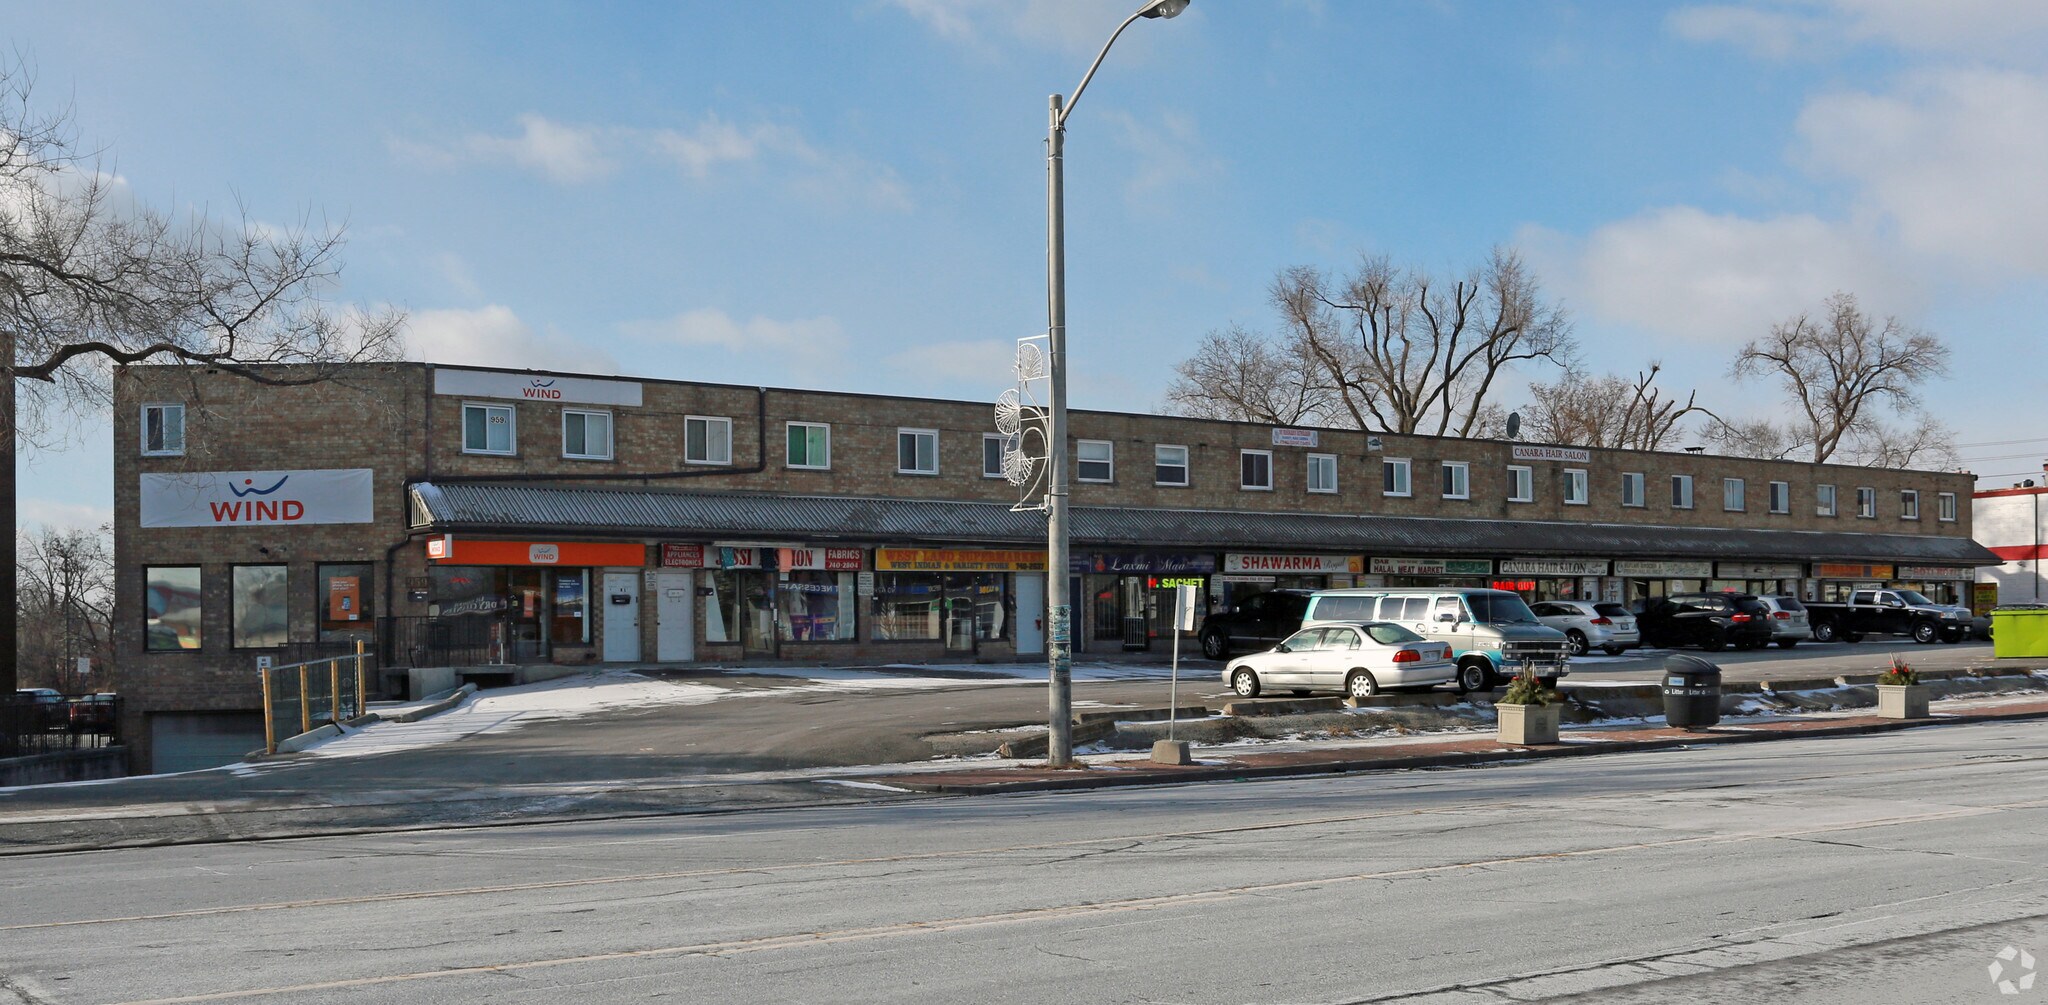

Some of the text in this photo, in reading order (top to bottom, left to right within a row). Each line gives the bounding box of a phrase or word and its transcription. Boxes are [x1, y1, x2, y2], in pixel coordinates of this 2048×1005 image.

[523, 387, 561, 399] WIND
[1514, 448, 1587, 460] CANARA HAIR SALON
[209, 500, 304, 522] WIND
[827, 549, 860, 559] FABRICS
[885, 550, 1045, 563] WEST LAND SUPERMARKET
[1111, 558, 1151, 571] Laxmi
[1241, 556, 1347, 571] SHAWARMA Royal
[1373, 565, 1395, 573] HALAL
[1398, 566, 1415, 574] MEAT
[1418, 566, 1444, 574] MARKET
[1501, 561, 1536, 573] CANARA
[1537, 561, 1559, 573] HAIR
[1559, 562, 1587, 574] SALON
[1162, 578, 1205, 588] SACHET
